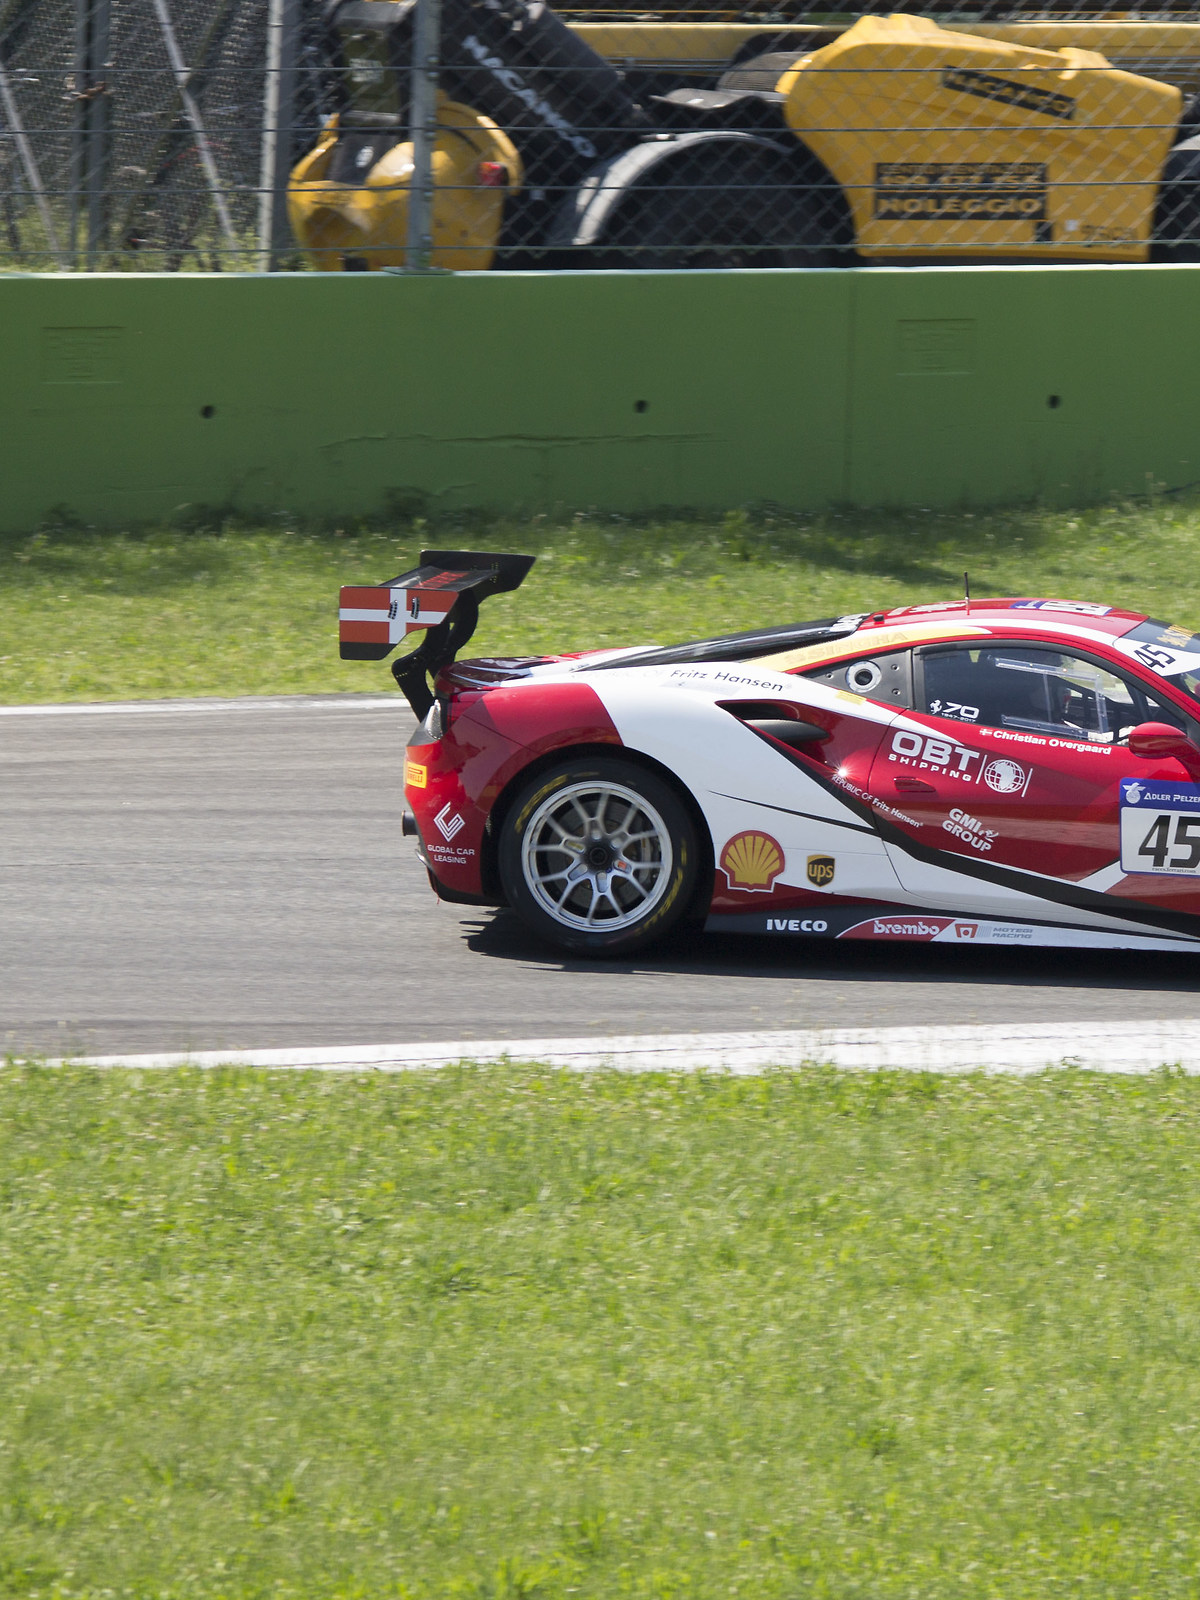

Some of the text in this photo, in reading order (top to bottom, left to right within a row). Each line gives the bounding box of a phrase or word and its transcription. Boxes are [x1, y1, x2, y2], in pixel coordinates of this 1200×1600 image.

[878, 198, 1042, 213] NOLEGGIO
[1133, 644, 1177, 669] 45
[670, 669, 708, 679] Fritz
[942, 702, 980, 719] 70
[891, 731, 980, 771] OBT
[993, 730, 1112, 755] Christian Overgaard
[888, 753, 972, 782] SHIPPING
[831, 774, 862, 796] REPUBLIC
[861, 792, 873, 801] OF
[872, 797, 890, 812] Fritz
[1143, 792, 1171, 801] ADLER
[942, 820, 992, 852] GROUP
[427, 844, 455, 854] GLOBAL
[433, 855, 467, 864] LEASING
[808, 864, 833, 883] ups
[766, 918, 828, 932] IVECO
[873, 919, 941, 935] brembo
